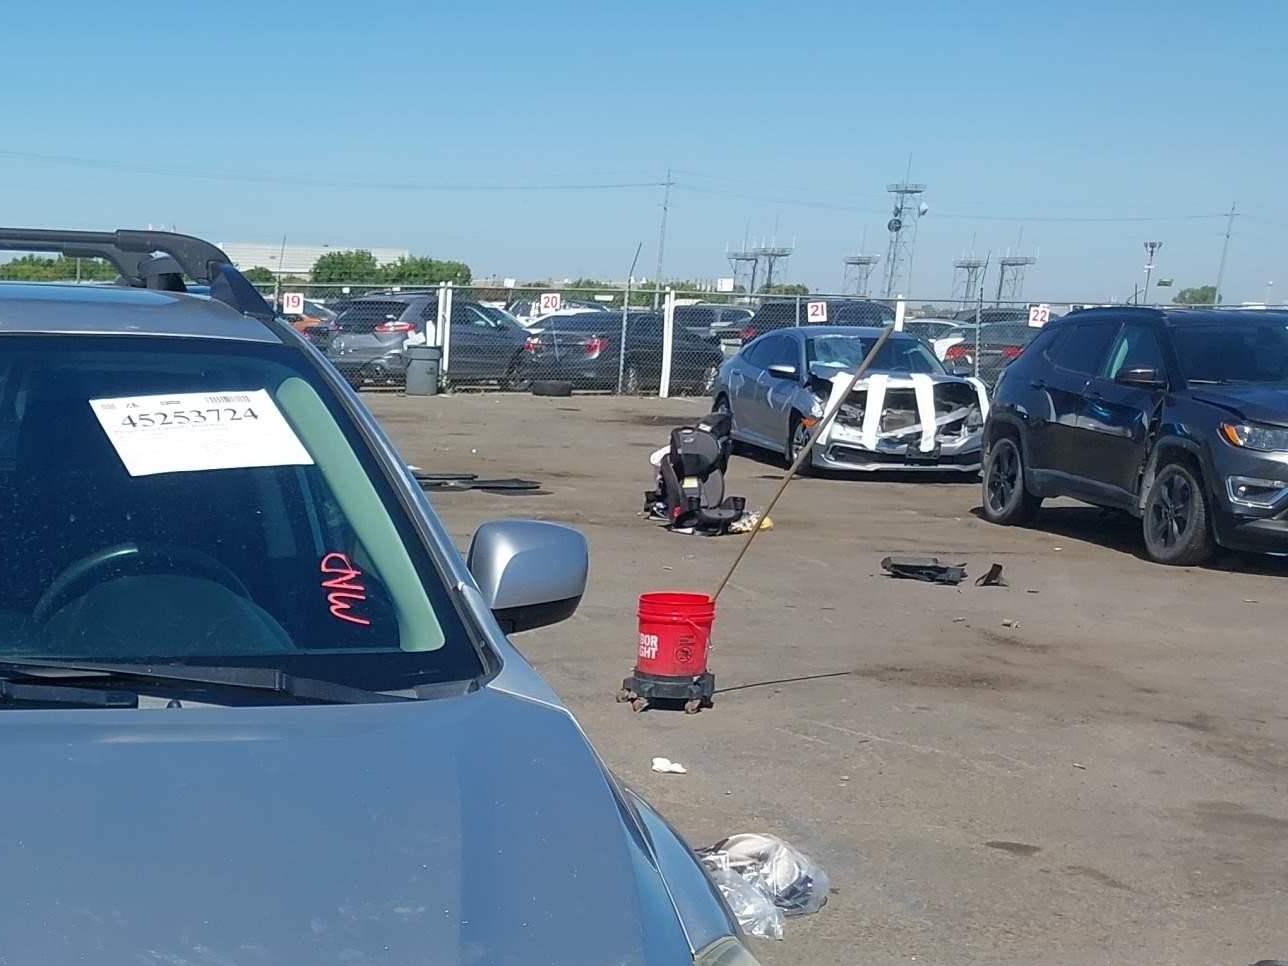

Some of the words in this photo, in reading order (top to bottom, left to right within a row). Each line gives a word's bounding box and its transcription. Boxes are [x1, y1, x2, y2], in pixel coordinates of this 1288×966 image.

[286, 295, 300, 309] 19
[543, 295, 558, 309] 20
[810, 303, 825, 317] 21
[1032, 308, 1047, 322] 22
[121, 407, 259, 428] 45253724
